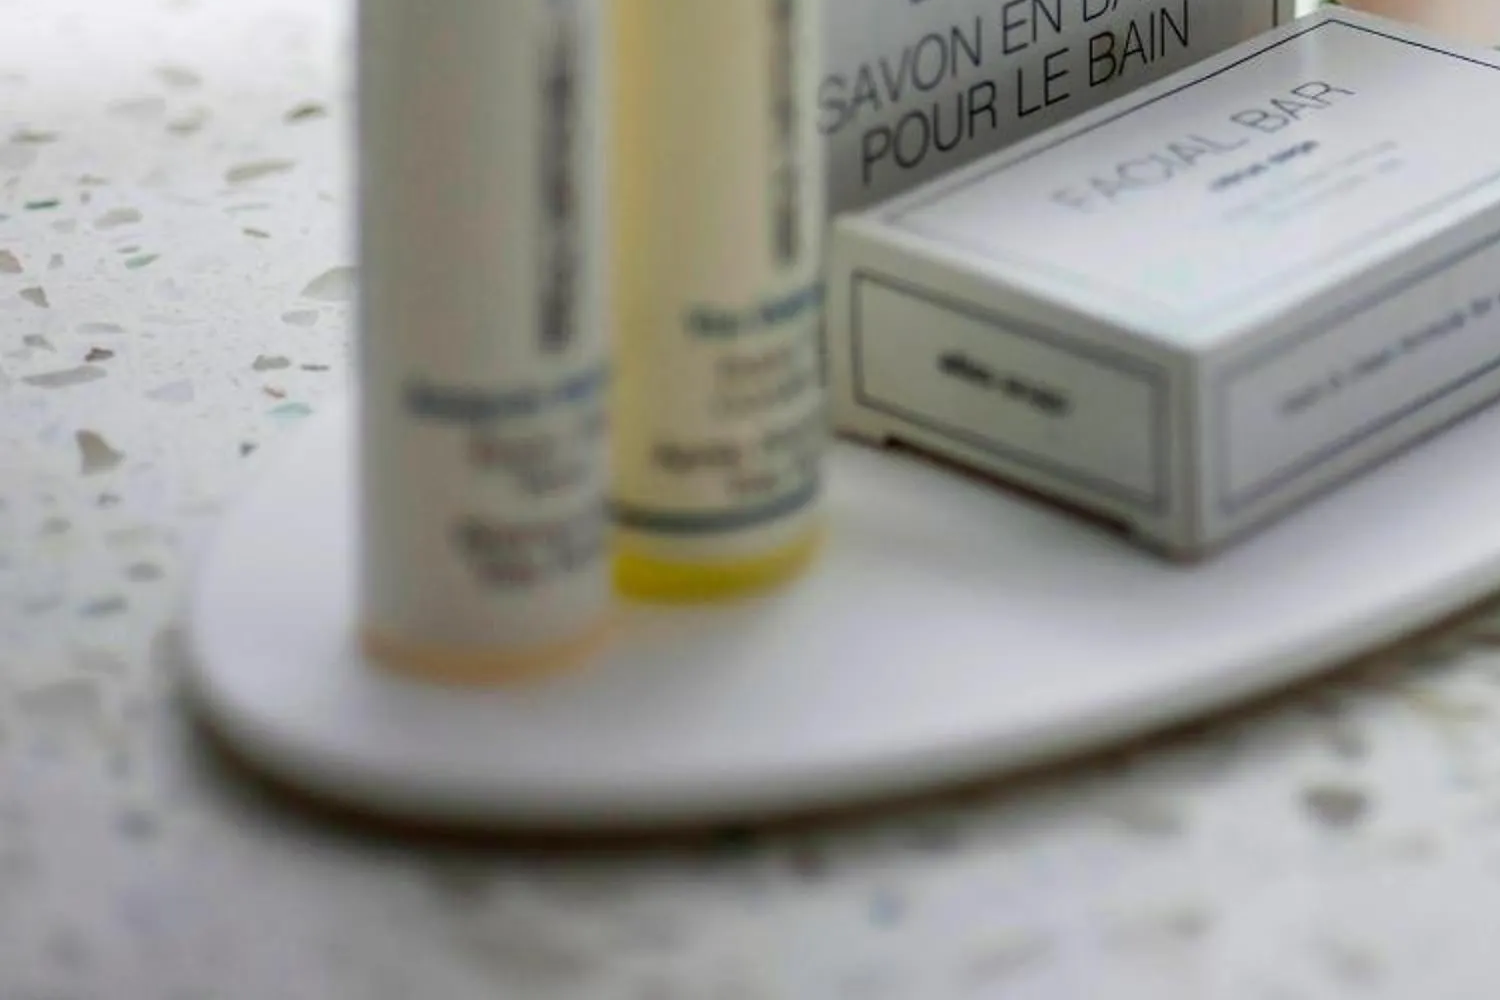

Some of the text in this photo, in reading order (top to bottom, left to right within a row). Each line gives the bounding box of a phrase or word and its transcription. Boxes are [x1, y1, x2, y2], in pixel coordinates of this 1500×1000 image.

[816, 15, 983, 136] SAVON
[861, 78, 998, 187] POUR
[1016, 49, 1071, 119] LE
[1050, 133, 1251, 215] FACIAL
[1230, 80, 1356, 134] BAR
